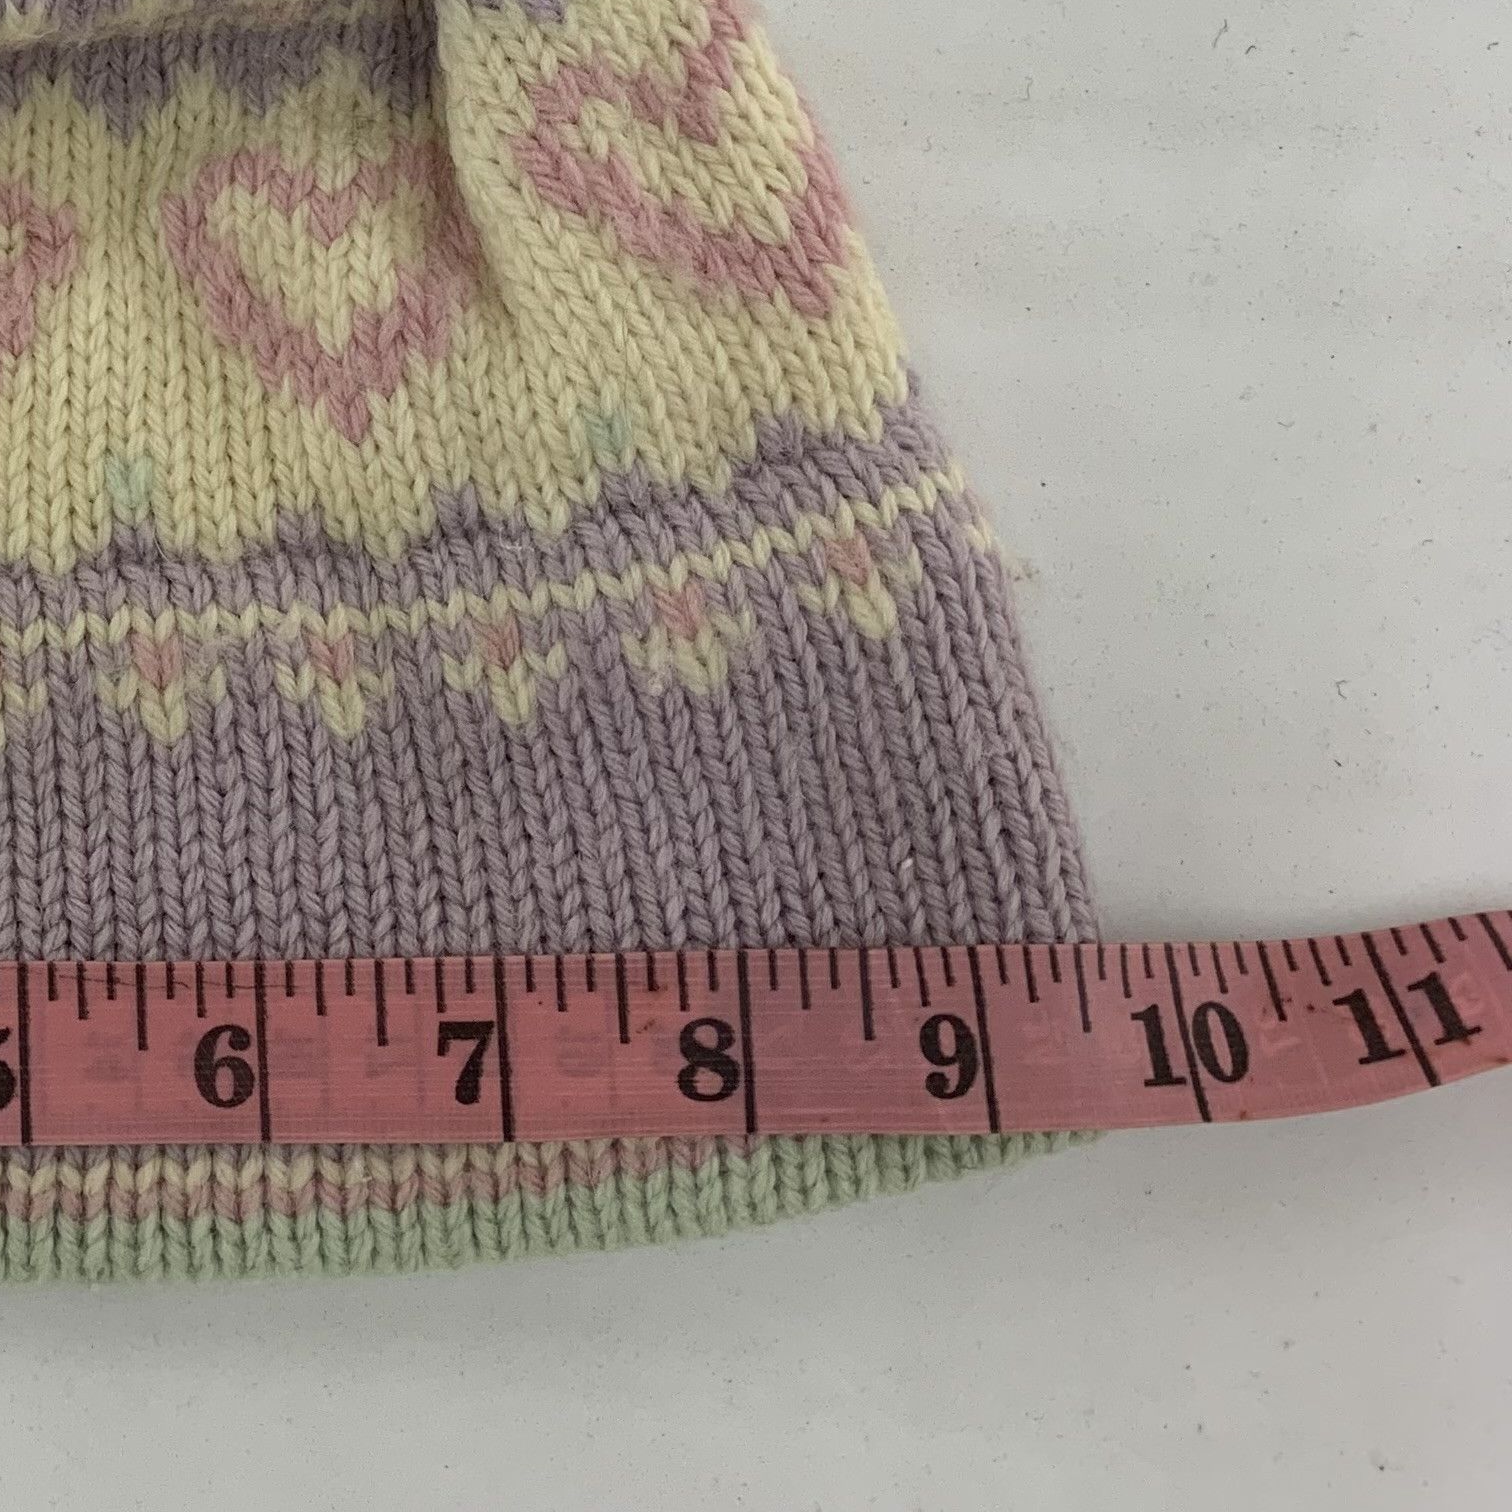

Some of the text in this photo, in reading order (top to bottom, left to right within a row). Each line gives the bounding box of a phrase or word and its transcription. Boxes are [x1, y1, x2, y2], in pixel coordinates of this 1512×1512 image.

[676, 1017, 741, 1103] 8
[918, 1013, 979, 1100] 9
[1130, 1000, 1250, 1088] 10
[1332, 970, 1483, 1066] 11
[193, 1024, 256, 1109] 6
[437, 1020, 496, 1105] 7
